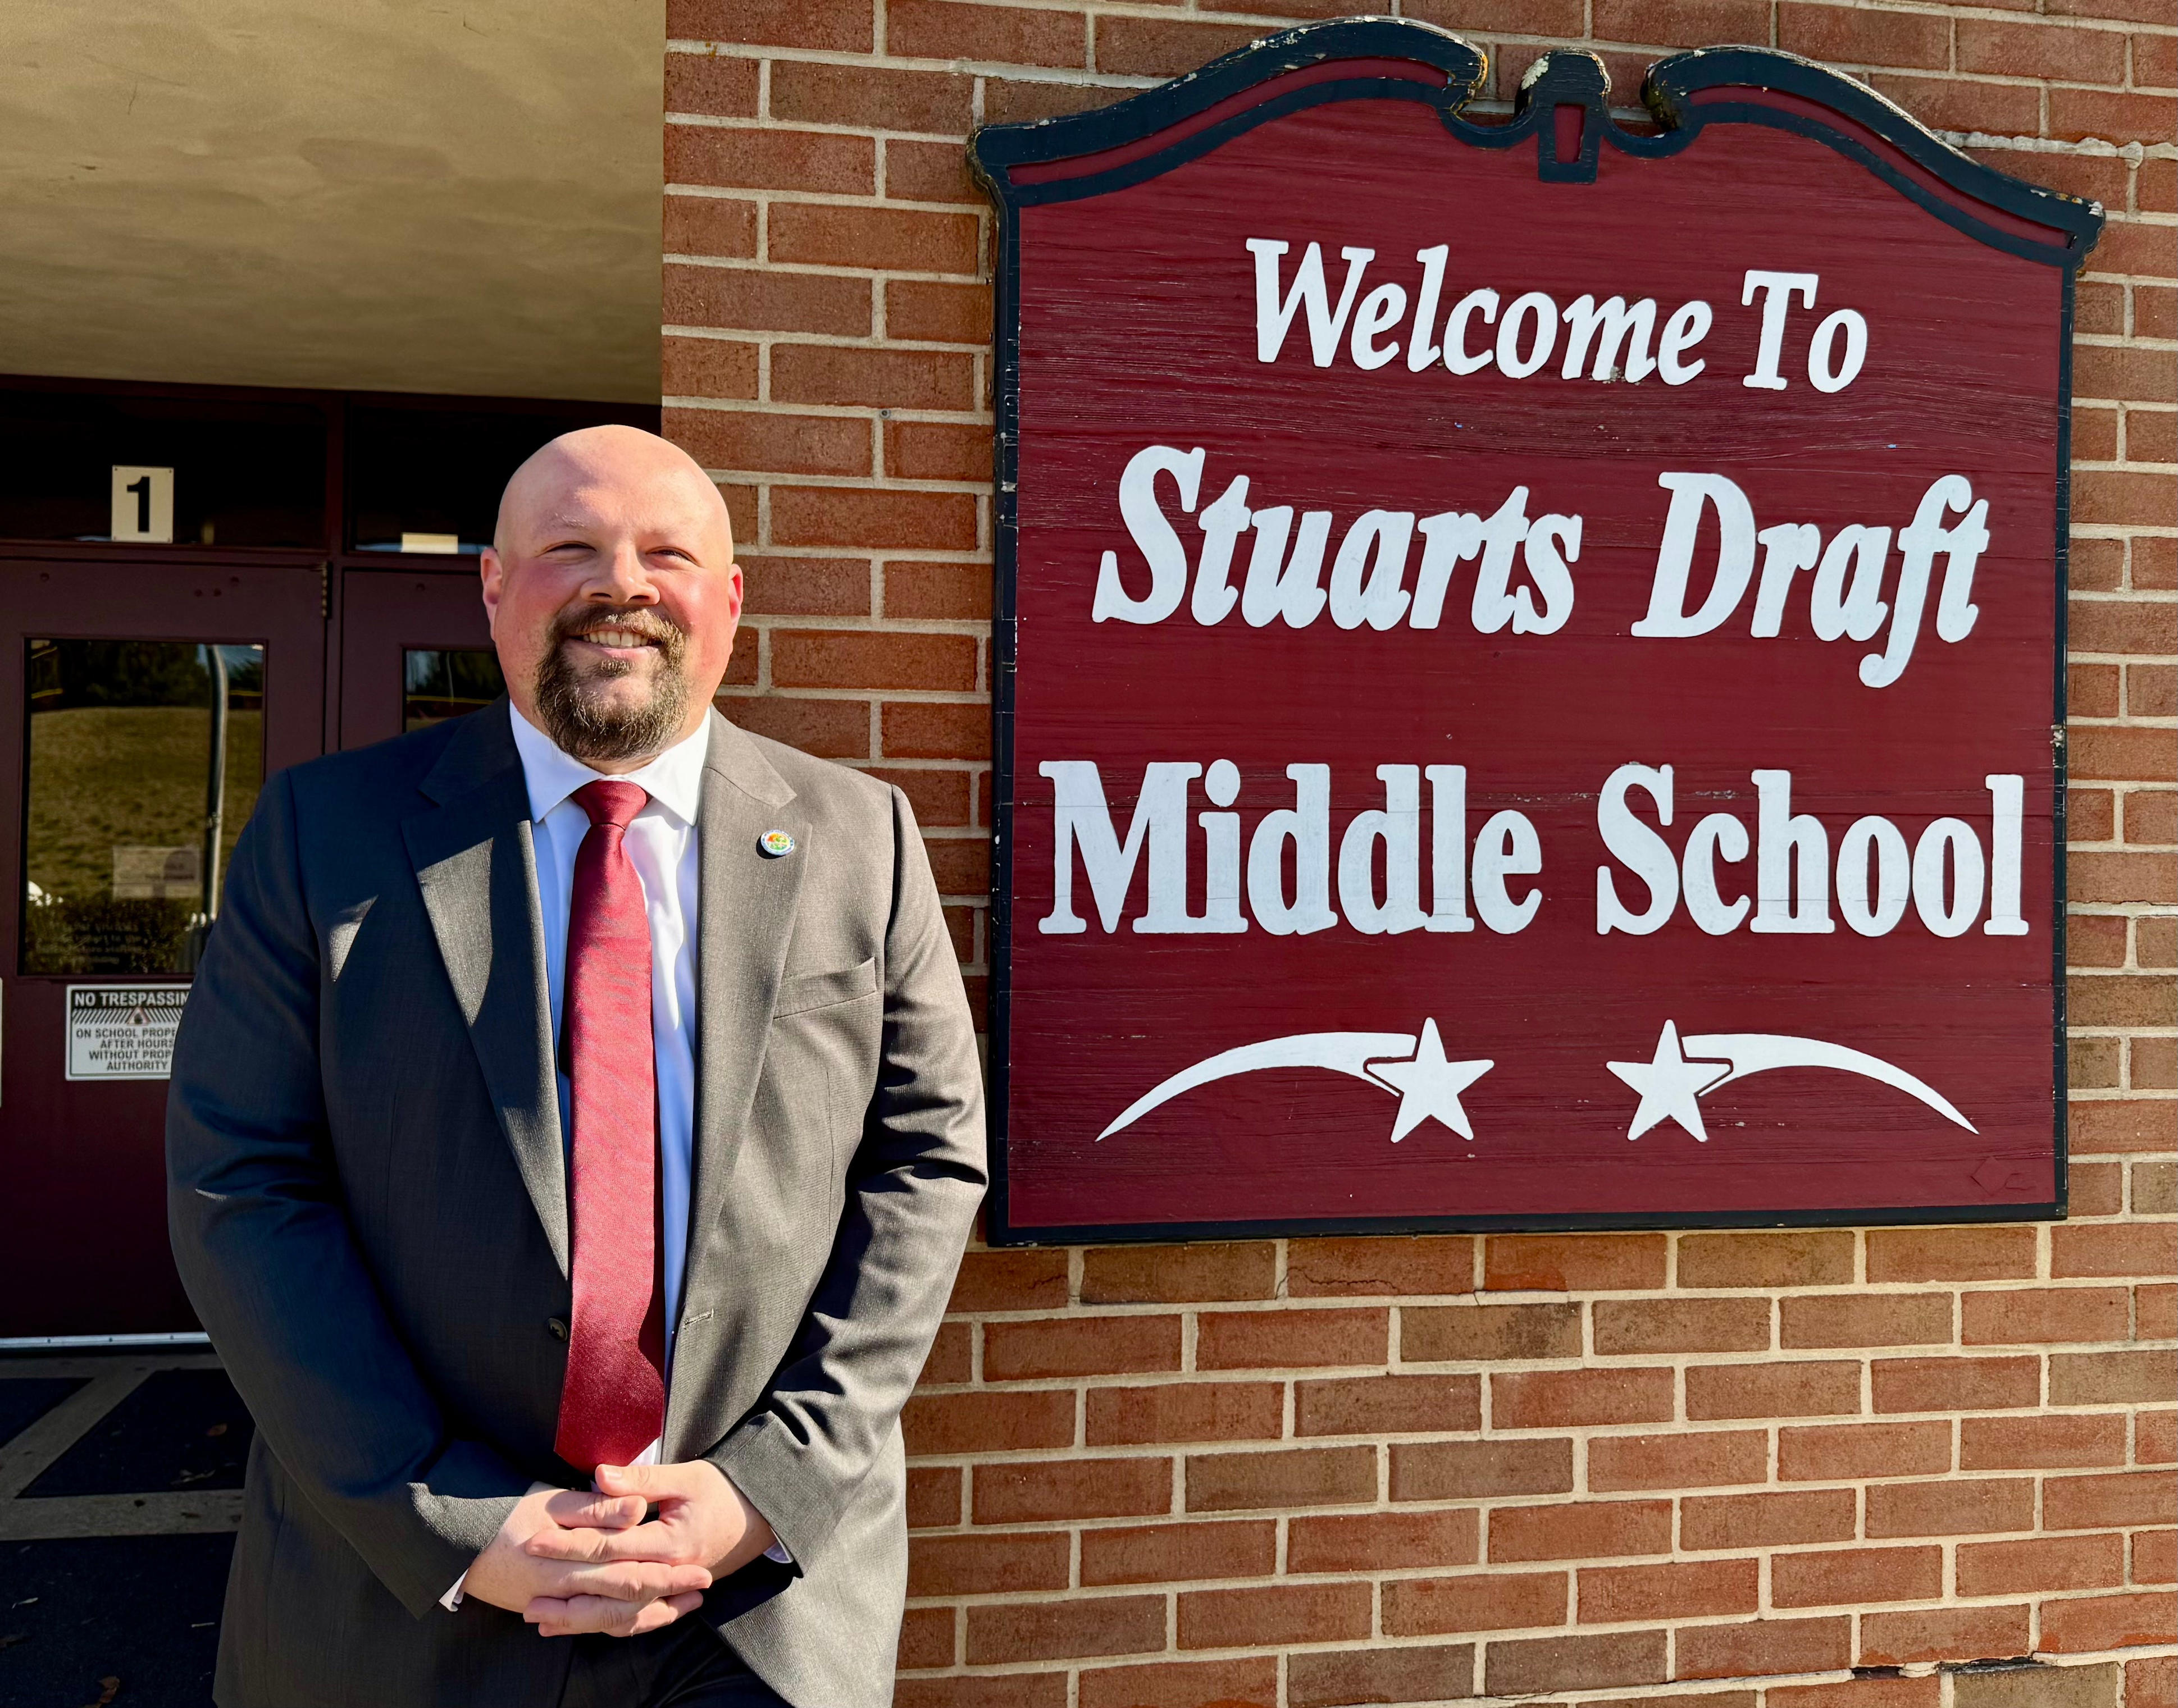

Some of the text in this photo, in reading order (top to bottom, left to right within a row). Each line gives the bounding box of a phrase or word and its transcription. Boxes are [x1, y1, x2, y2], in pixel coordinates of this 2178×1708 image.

[1245, 238, 1869, 394] Welcome To
[126, 476, 150, 533] 1
[1092, 444, 1991, 689] Stuarts Draft
[1038, 759, 2030, 939] Middle School
[75, 992, 96, 1006] NO
[76, 1028, 91, 1038] ON
[95, 1028, 138, 1038] SCHOOL
[100, 1039, 173, 1048] AFTER HOURS
[89, 1050, 139, 1060] WITHOUT
[107, 1061, 168, 1071] AUTHORITY
